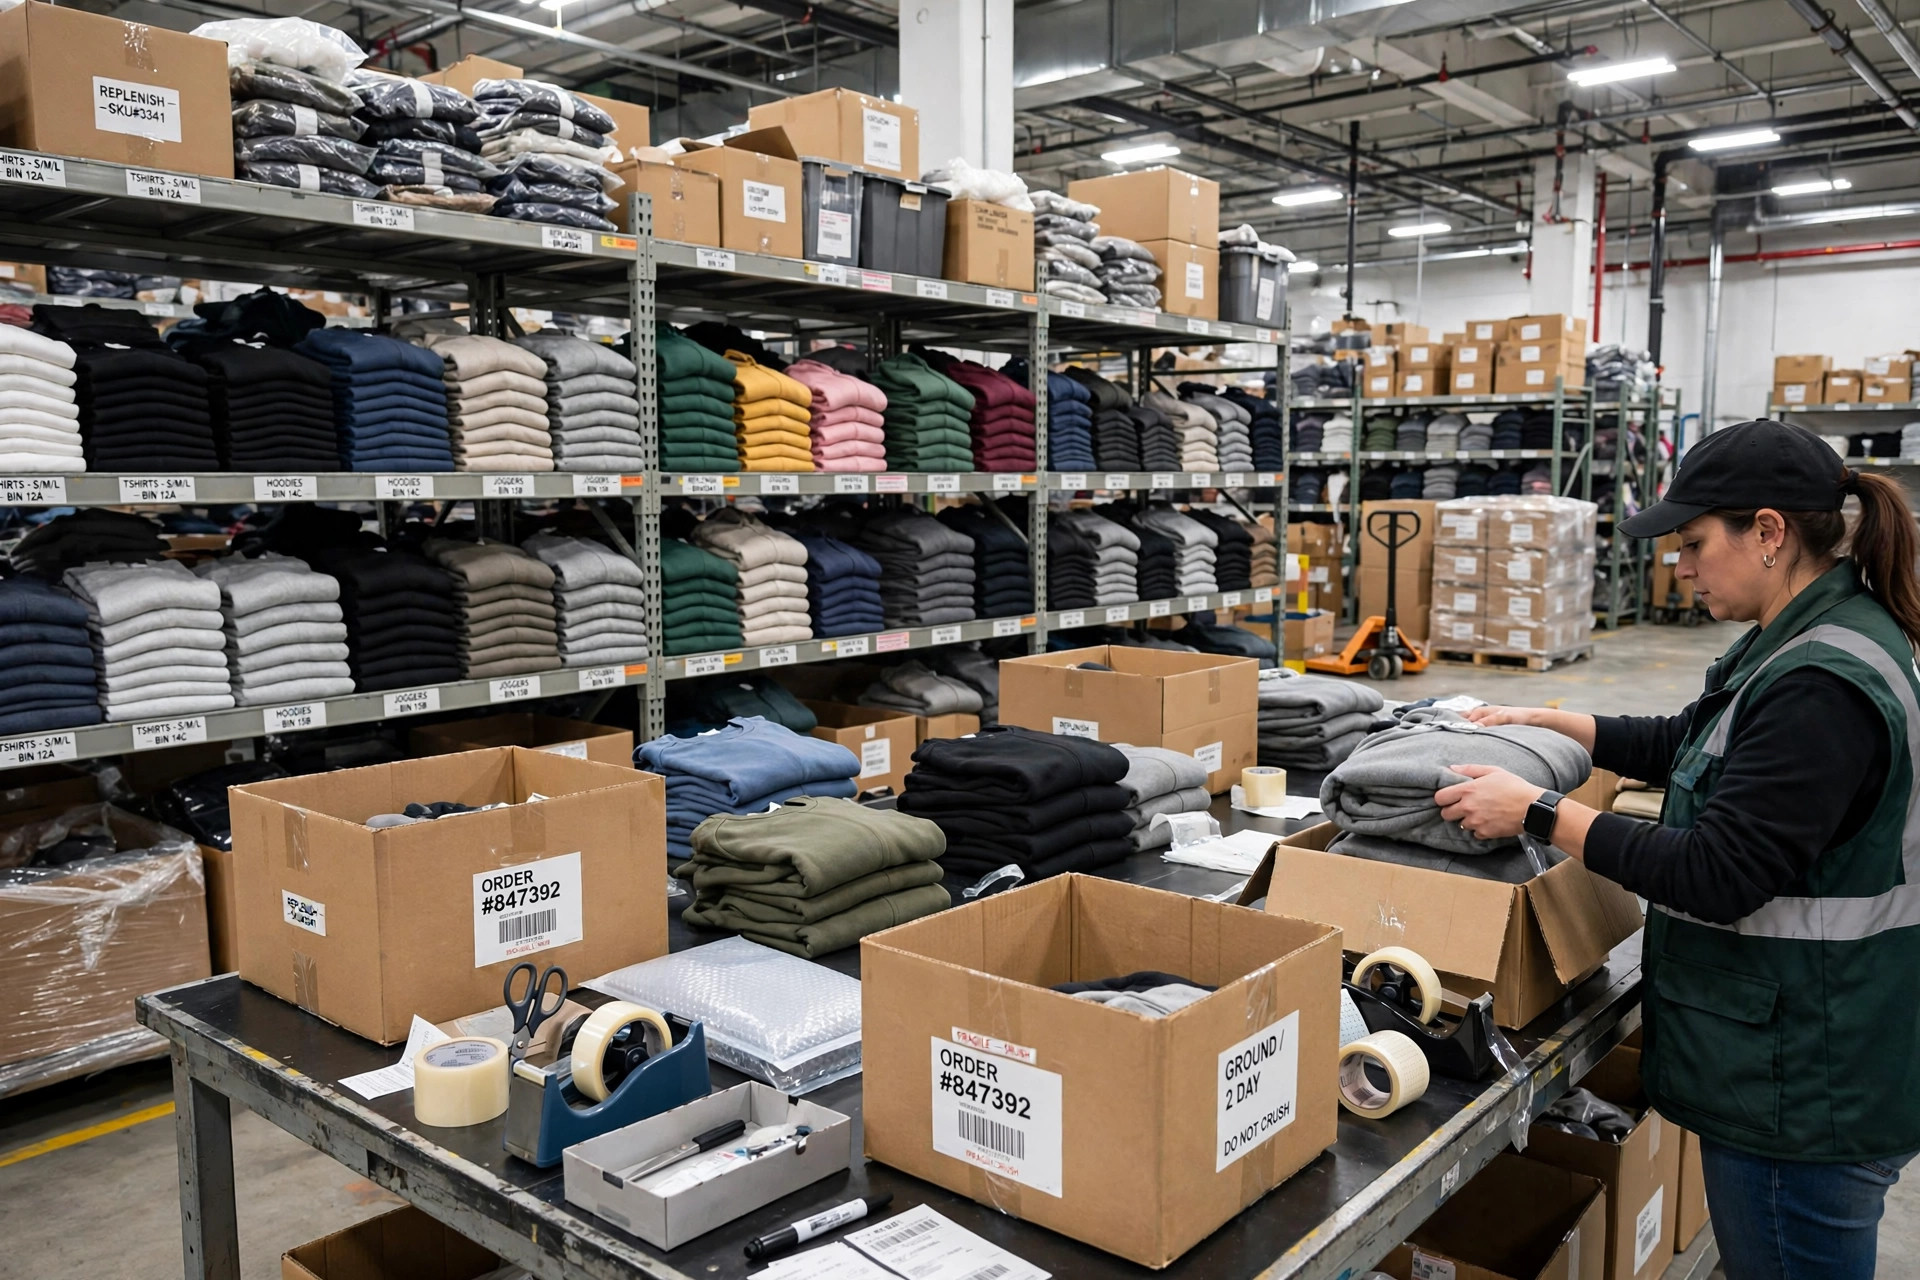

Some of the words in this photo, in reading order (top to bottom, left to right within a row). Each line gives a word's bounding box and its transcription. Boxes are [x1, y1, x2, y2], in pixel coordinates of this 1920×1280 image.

[99, 85, 165, 107] REPLENISH
[0, 155, 25, 166] HIRTS
[34, 159, 61, 172] S/M/L
[6, 168, 22, 178] BIN
[26, 171, 44, 182] 12A
[130, 173, 165, 186] TSHIRTS
[173, 178, 196, 190] S/M/L
[149, 186, 164, 197] BIN
[166, 189, 182, 199] 12A
[370, 216, 383, 224] BIN
[0, 480, 25, 489] HIRTS
[33, 480, 60, 489] S/M/L
[124, 480, 159, 488] TSHIRTS
[167, 480, 191, 488] S/M/L
[267, 479, 303, 487] HOODIES
[7, 493, 23, 501] BIN
[27, 492, 43, 501] 12A
[142, 491, 157, 499] BIN
[160, 491, 176, 499] 12A
[272, 490, 286, 498] BIN
[289, 490, 302, 498] 14C
[392, 489, 405, 497] BIN
[276, 706, 312, 718] HOODIES
[400, 703, 412, 712] BIN
[137, 723, 171, 735] TSHIRTS
[178, 720, 202, 731] S/M/L
[282, 719, 295, 728] BIN
[45, 736, 71, 747] S/M/L
[155, 735, 170, 745] BIN
[172, 732, 187, 742] 14C
[18, 752, 34, 762] BIN
[38, 750, 55, 760] 12A
[482, 870, 534, 893] ORDER
[481, 881, 561, 915] #847392
[1225, 1035, 1277, 1081] GROUND
[1279, 1029, 1285, 1052] /
[940, 1049, 998, 1083] ORDER
[940, 1071, 1031, 1120] #847392
[1225, 1089, 1233, 1111] 2
[1236, 1071, 1261, 1104] DAY
[1224, 1135, 1238, 1157] DO
[1240, 1121, 1259, 1146] NOT
[1260, 1101, 1290, 1132] CRUSH
